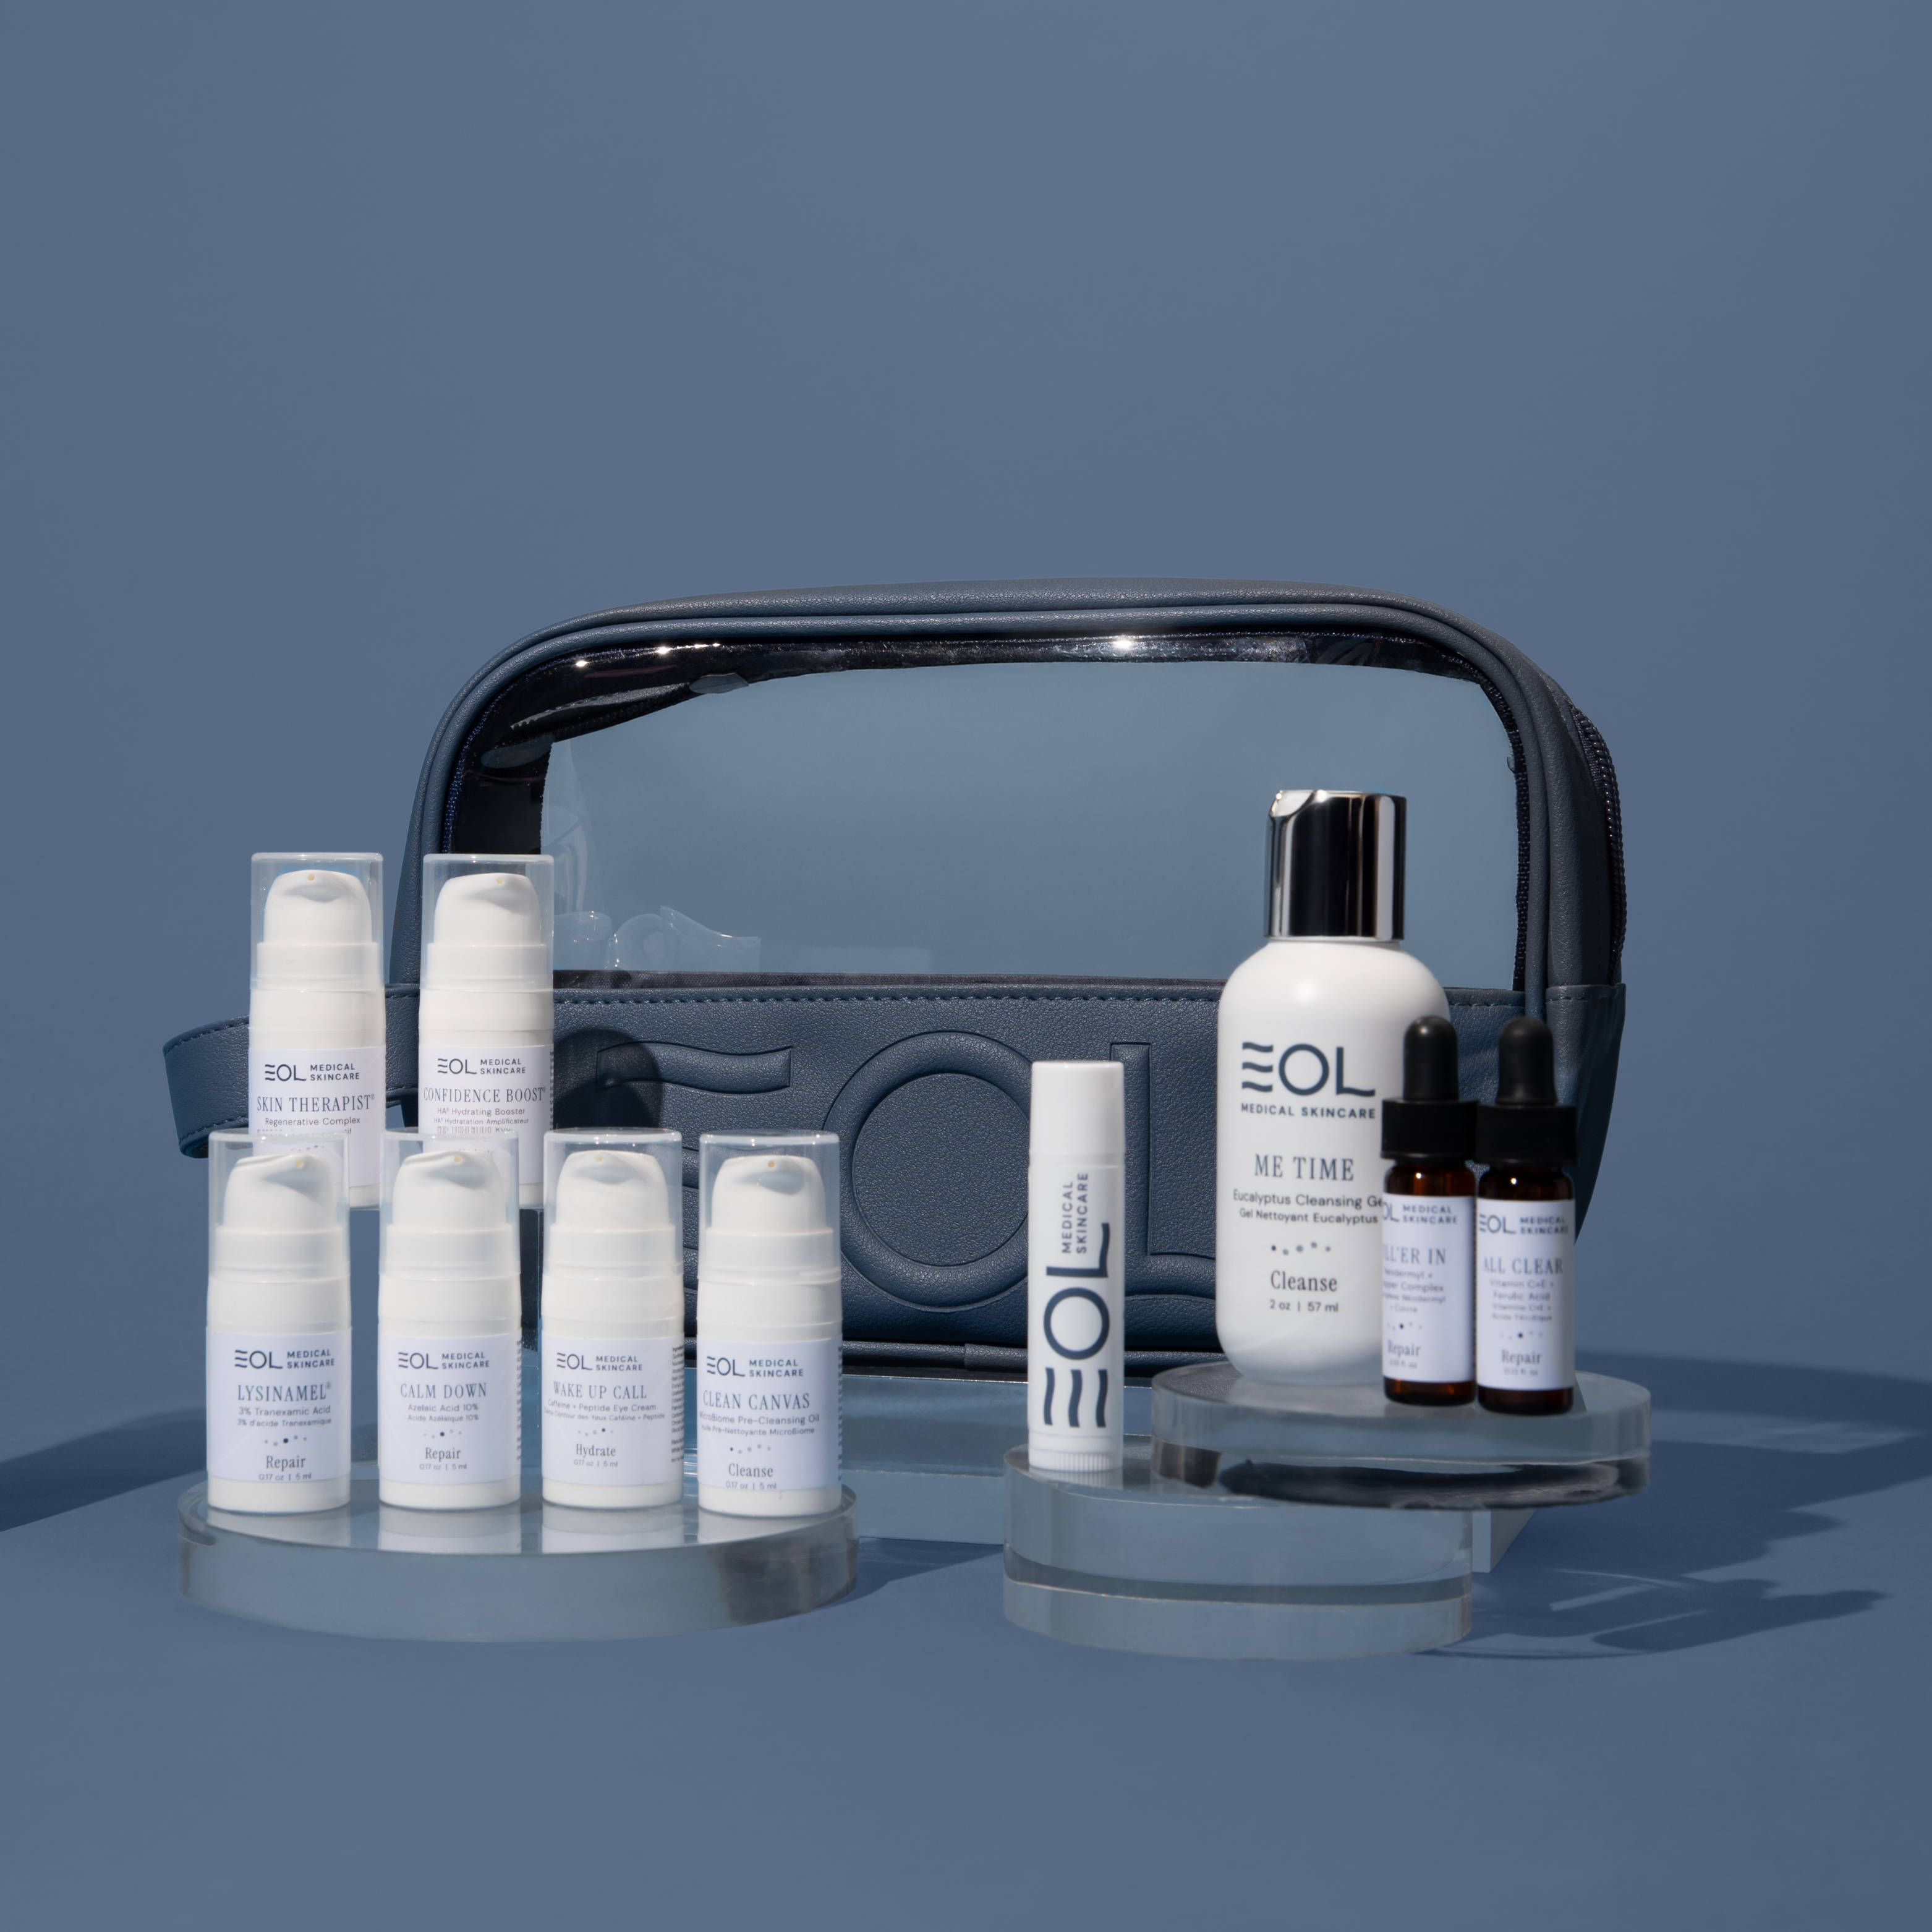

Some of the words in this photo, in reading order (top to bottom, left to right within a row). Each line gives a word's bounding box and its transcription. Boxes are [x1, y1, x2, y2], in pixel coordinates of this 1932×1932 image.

[265, 1064, 307, 1081] EOL
[310, 1063, 355, 1071] MEDICAL
[438, 1058, 477, 1075] EOL
[1241, 1042, 1375, 1097] EOL
[310, 1072, 360, 1081] SKINCARE
[423, 1087, 500, 1103] CONFIDENCE
[257, 1096, 283, 1112] SKIN
[1241, 1103, 1294, 1116] MEDICAL
[1301, 1107, 1376, 1118] SKINCARE
[452, 1108, 492, 1117] Hydrating
[265, 1117, 318, 1127] Regenerative
[323, 1117, 360, 1126] Complex
[1254, 1154, 1283, 1178] ME
[1293, 1156, 1353, 1181] TIME
[1233, 1189, 1291, 1206] Eucalyptus
[1296, 1194, 1362, 1209] Cleansing
[1367, 1196, 1383, 1207] Ge
[1076, 1173, 1088, 1254] SKINCARE
[1240, 1208, 1253, 1217] Gel
[1256, 1211, 1308, 1223] Nettoyant
[1313, 1213, 1378, 1225] Eucalyptus
[1403, 1205, 1453, 1214] MEDICAL
[1062, 1181, 1073, 1254] MEDICAL
[1403, 1215, 1457, 1223] SKINCARE
[1479, 1214, 1517, 1235] EOL
[1520, 1216, 1565, 1224] MEDICAL
[1428, 1249, 1445, 1264] IN
[1484, 1256, 1505, 1274] ALL
[1512, 1257, 1563, 1275] CLEAR
[1270, 1270, 1337, 1292] Cleanse
[1270, 1300, 1275, 1309] 2
[1308, 1302, 1321, 1311] 57
[1326, 1303, 1338, 1312] ml
[1044, 1222, 1110, 1428] EOL
[287, 1349, 331, 1358] MEDICAL
[1387, 1339, 1421, 1357] Repair
[235, 1350, 283, 1369] EOL
[287, 1358, 335, 1369] SKINCARE
[398, 1352, 438, 1369] EOL
[556, 1352, 593, 1371] EOL
[749, 1359, 799, 1367] MEDICAL
[1501, 1348, 1542, 1366] Repair
[442, 1361, 490, 1369] SKINCARE
[707, 1356, 746, 1377] EOL
[749, 1369, 804, 1377] SKINCARE
[401, 1383, 436, 1398] CALM
[444, 1382, 487, 1398] DOWN
[553, 1381, 582, 1398] WAKE
[589, 1385, 607, 1399] UP
[613, 1385, 647, 1400] CALL
[408, 1403, 436, 1412] Azelaic
[440, 1404, 460, 1412] Acid
[548, 1399, 570, 1410] Caffeine
[579, 1403, 611, 1413] Peptide
[613, 1405, 628, 1413] Eye
[703, 1390, 741, 1409] CLEAN
[749, 1393, 810, 1410] CANVAS
[239, 1406, 251, 1415] 3%
[255, 1407, 309, 1416] Tranexamic
[312, 1405, 331, 1415] Acid
[555, 1410, 575, 1419] Contour
[643, 1413, 665, 1421] Peptide
[281, 1418, 332, 1428] Tranexamique
[738, 1415, 806, 1426] Pre-Cleansing
[808, 1413, 820, 1423] Oil
[770, 1427, 815, 1436] MicroBiome
[425, 1447, 461, 1462] Repair
[576, 1444, 616, 1458] Hydrate
[266, 1455, 306, 1471] Repair
[728, 1463, 773, 1478] Cleanse
